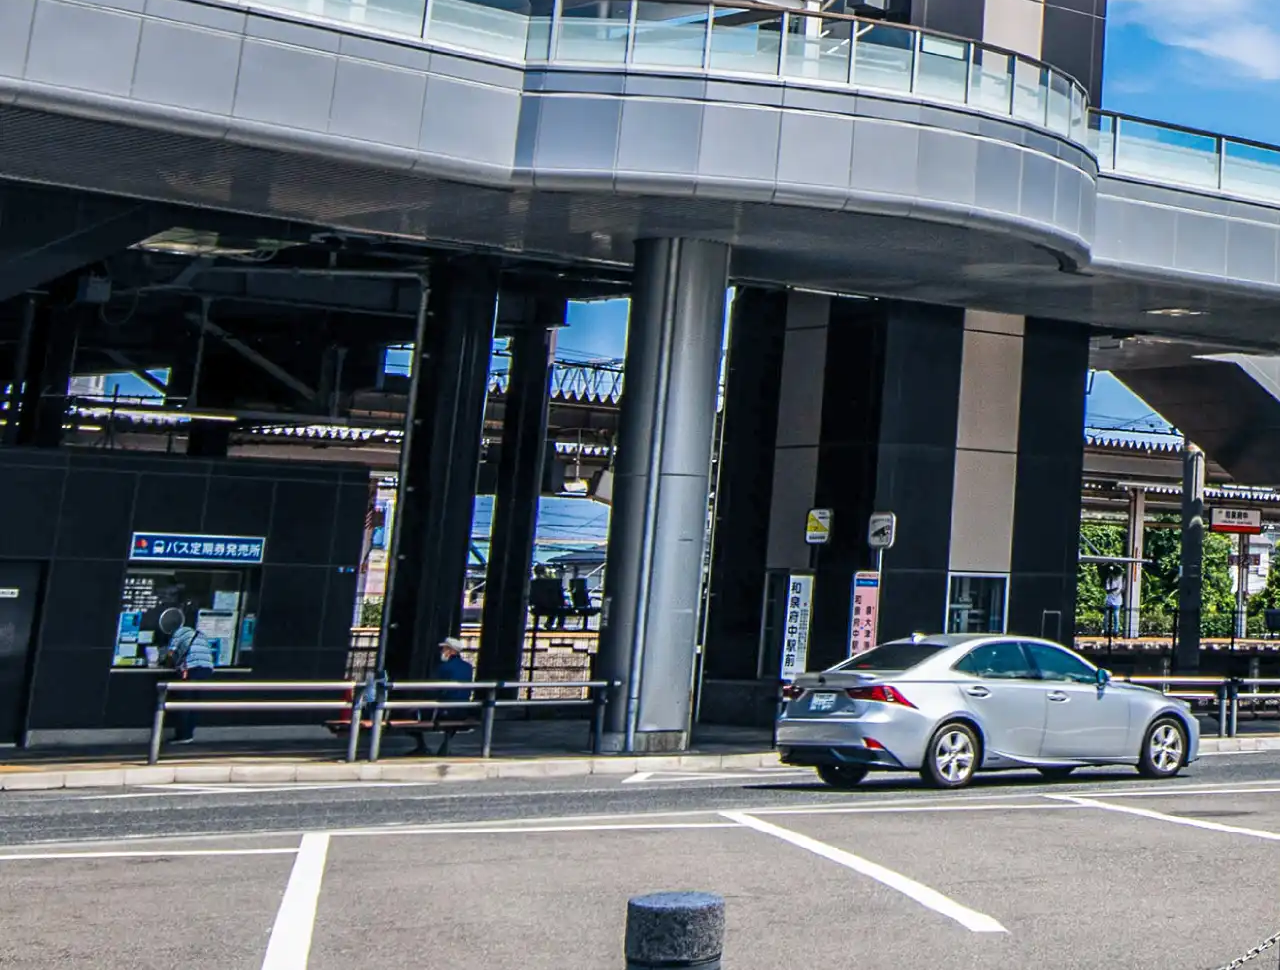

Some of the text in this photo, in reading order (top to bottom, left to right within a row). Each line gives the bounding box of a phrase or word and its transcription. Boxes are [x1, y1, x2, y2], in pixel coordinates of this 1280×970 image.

[166, 541, 261, 557] バス定期券発売所
[784, 581, 802, 667] 和泉府中駅前
[852, 595, 862, 656] 和泉府中駅
